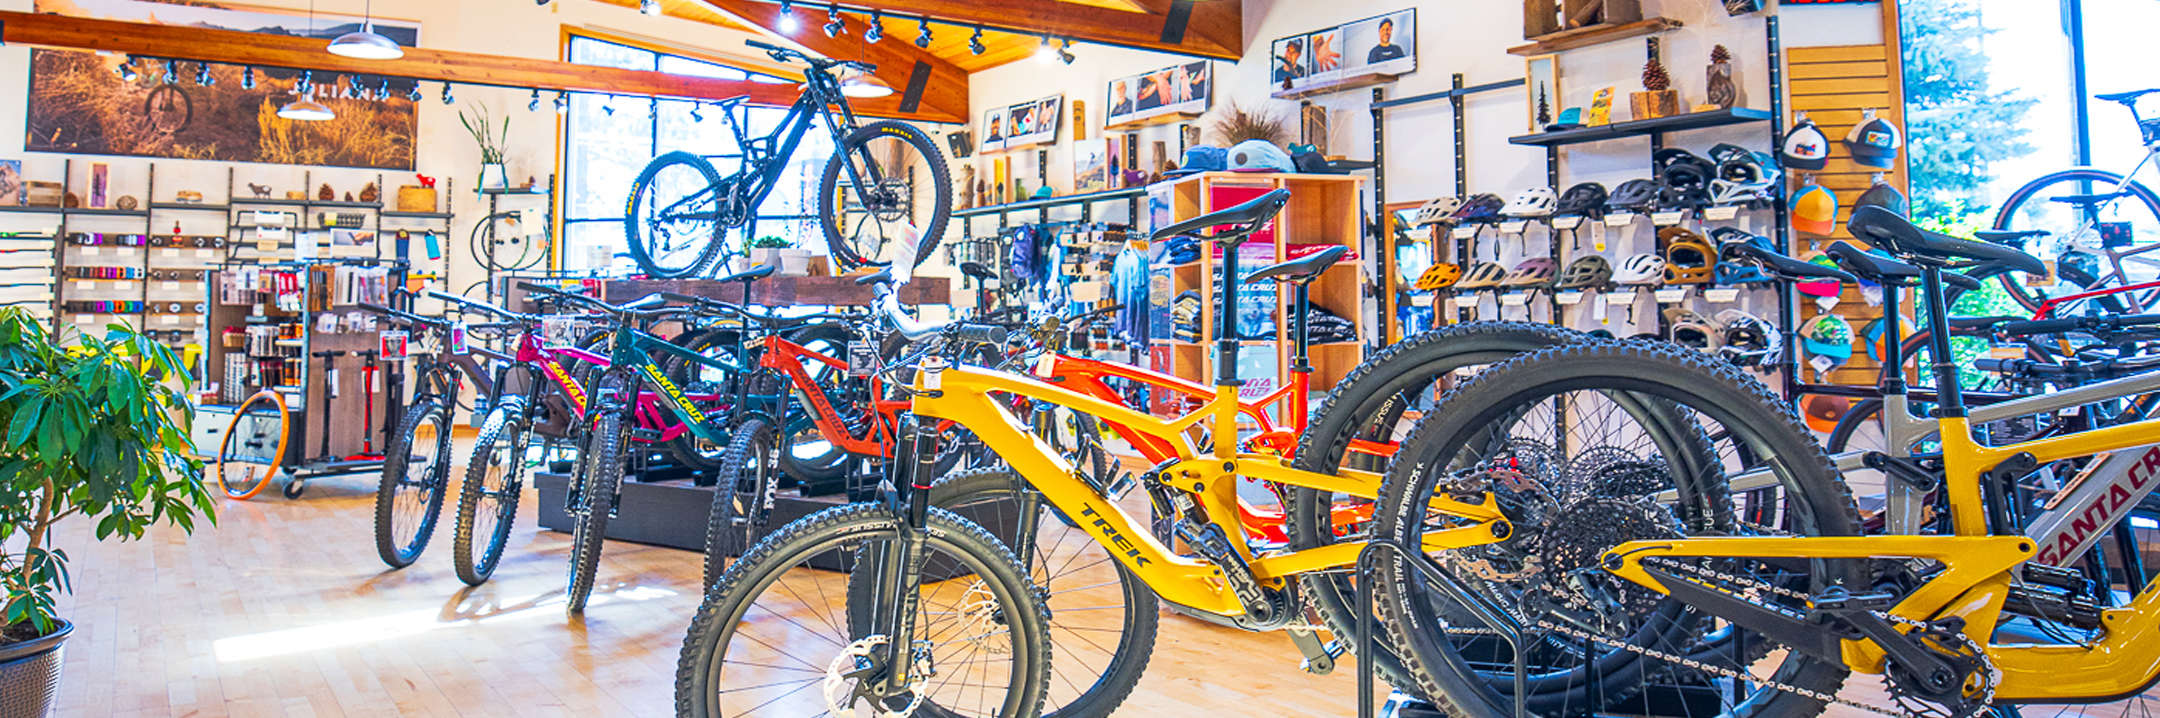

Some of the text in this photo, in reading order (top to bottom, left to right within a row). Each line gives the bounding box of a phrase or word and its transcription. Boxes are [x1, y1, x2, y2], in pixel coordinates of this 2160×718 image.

[547, 360, 582, 397] SANTA
[645, 364, 705, 423] SANTA CRUZ
[2038, 446, 2160, 567] SANTA CR
[1081, 502, 1152, 568] TREK
[1393, 517, 1405, 546] ALBE
[1394, 554, 1403, 583] TRAIL
